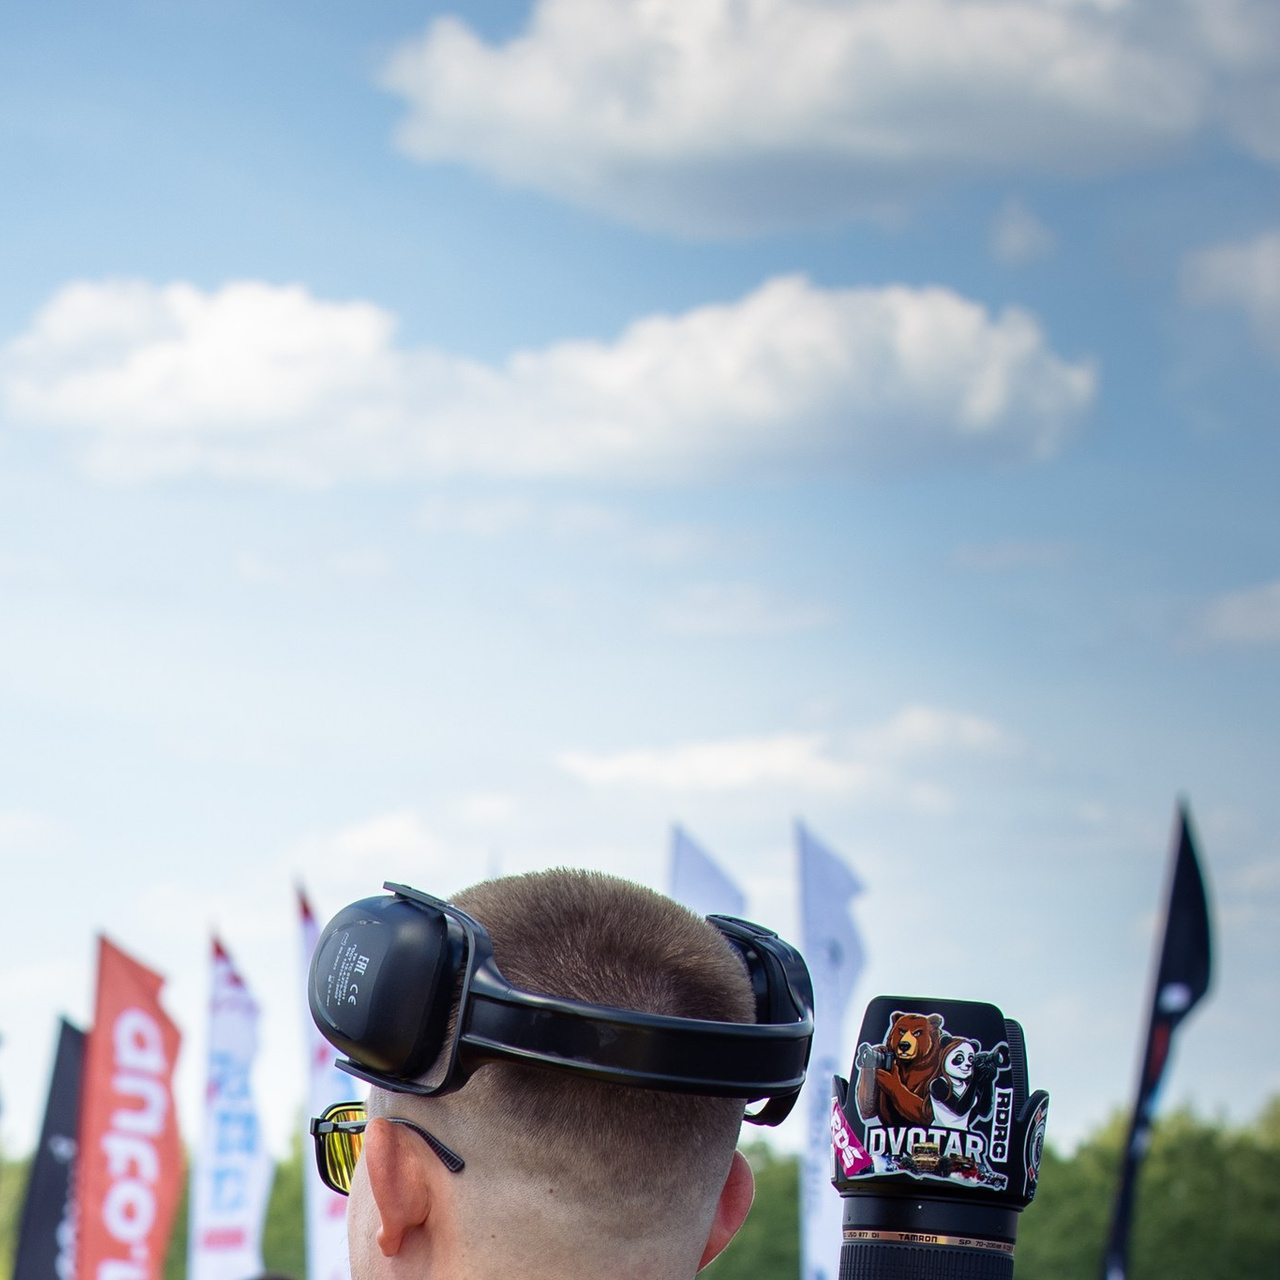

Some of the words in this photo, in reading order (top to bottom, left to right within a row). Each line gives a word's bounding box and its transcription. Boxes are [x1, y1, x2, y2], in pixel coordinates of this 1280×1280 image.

[991, 1091, 1012, 1160] RDRC
[870, 1127, 984, 1163] DVOTAR
[898, 1233, 938, 1243] TAMRON
